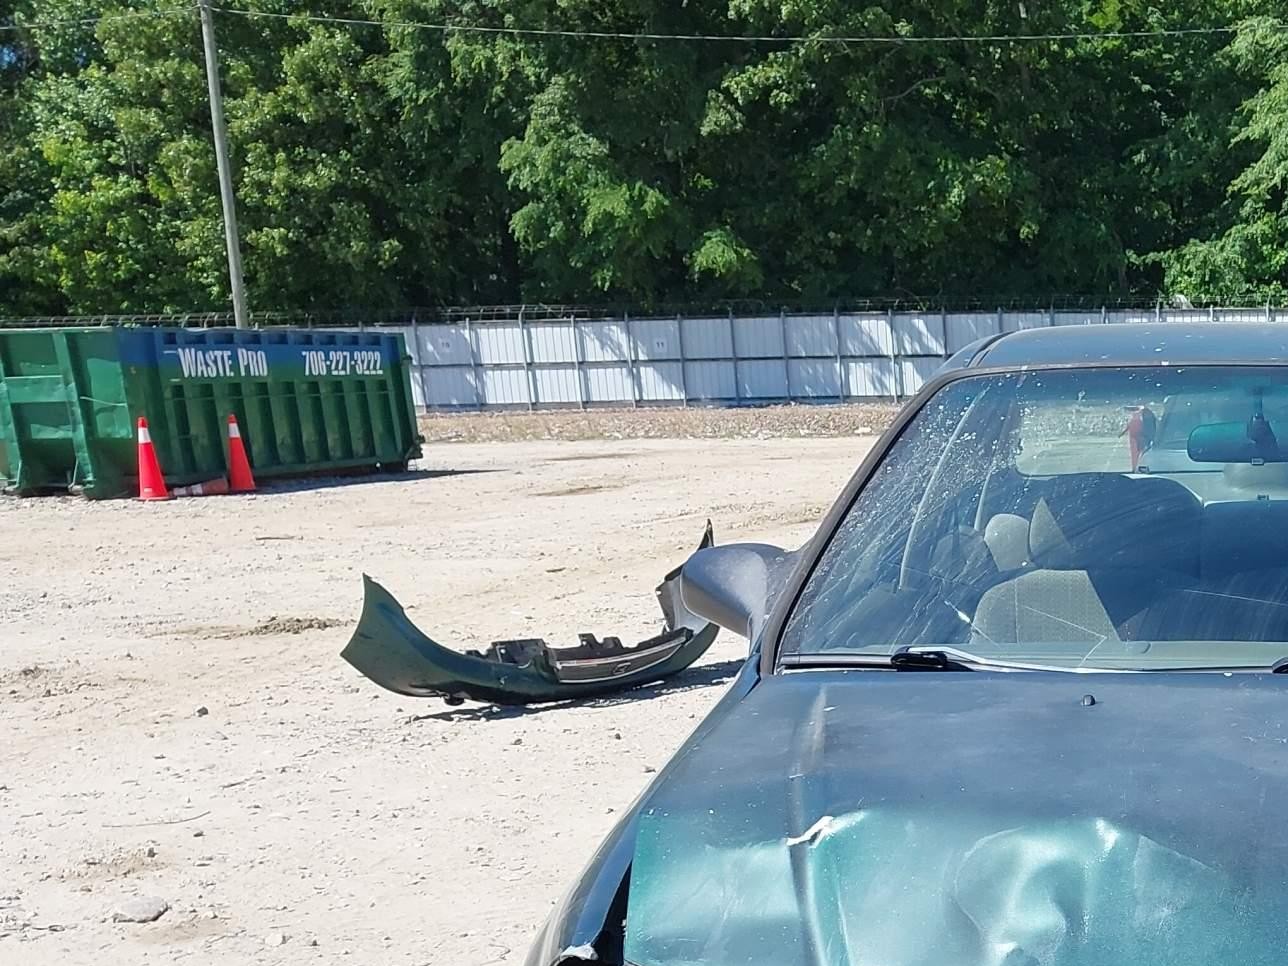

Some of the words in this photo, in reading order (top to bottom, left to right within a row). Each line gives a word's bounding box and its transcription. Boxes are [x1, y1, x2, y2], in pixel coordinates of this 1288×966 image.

[177, 347, 235, 378] WASTE
[238, 347, 269, 377] PRO
[302, 350, 384, 376] 706-227-3222
